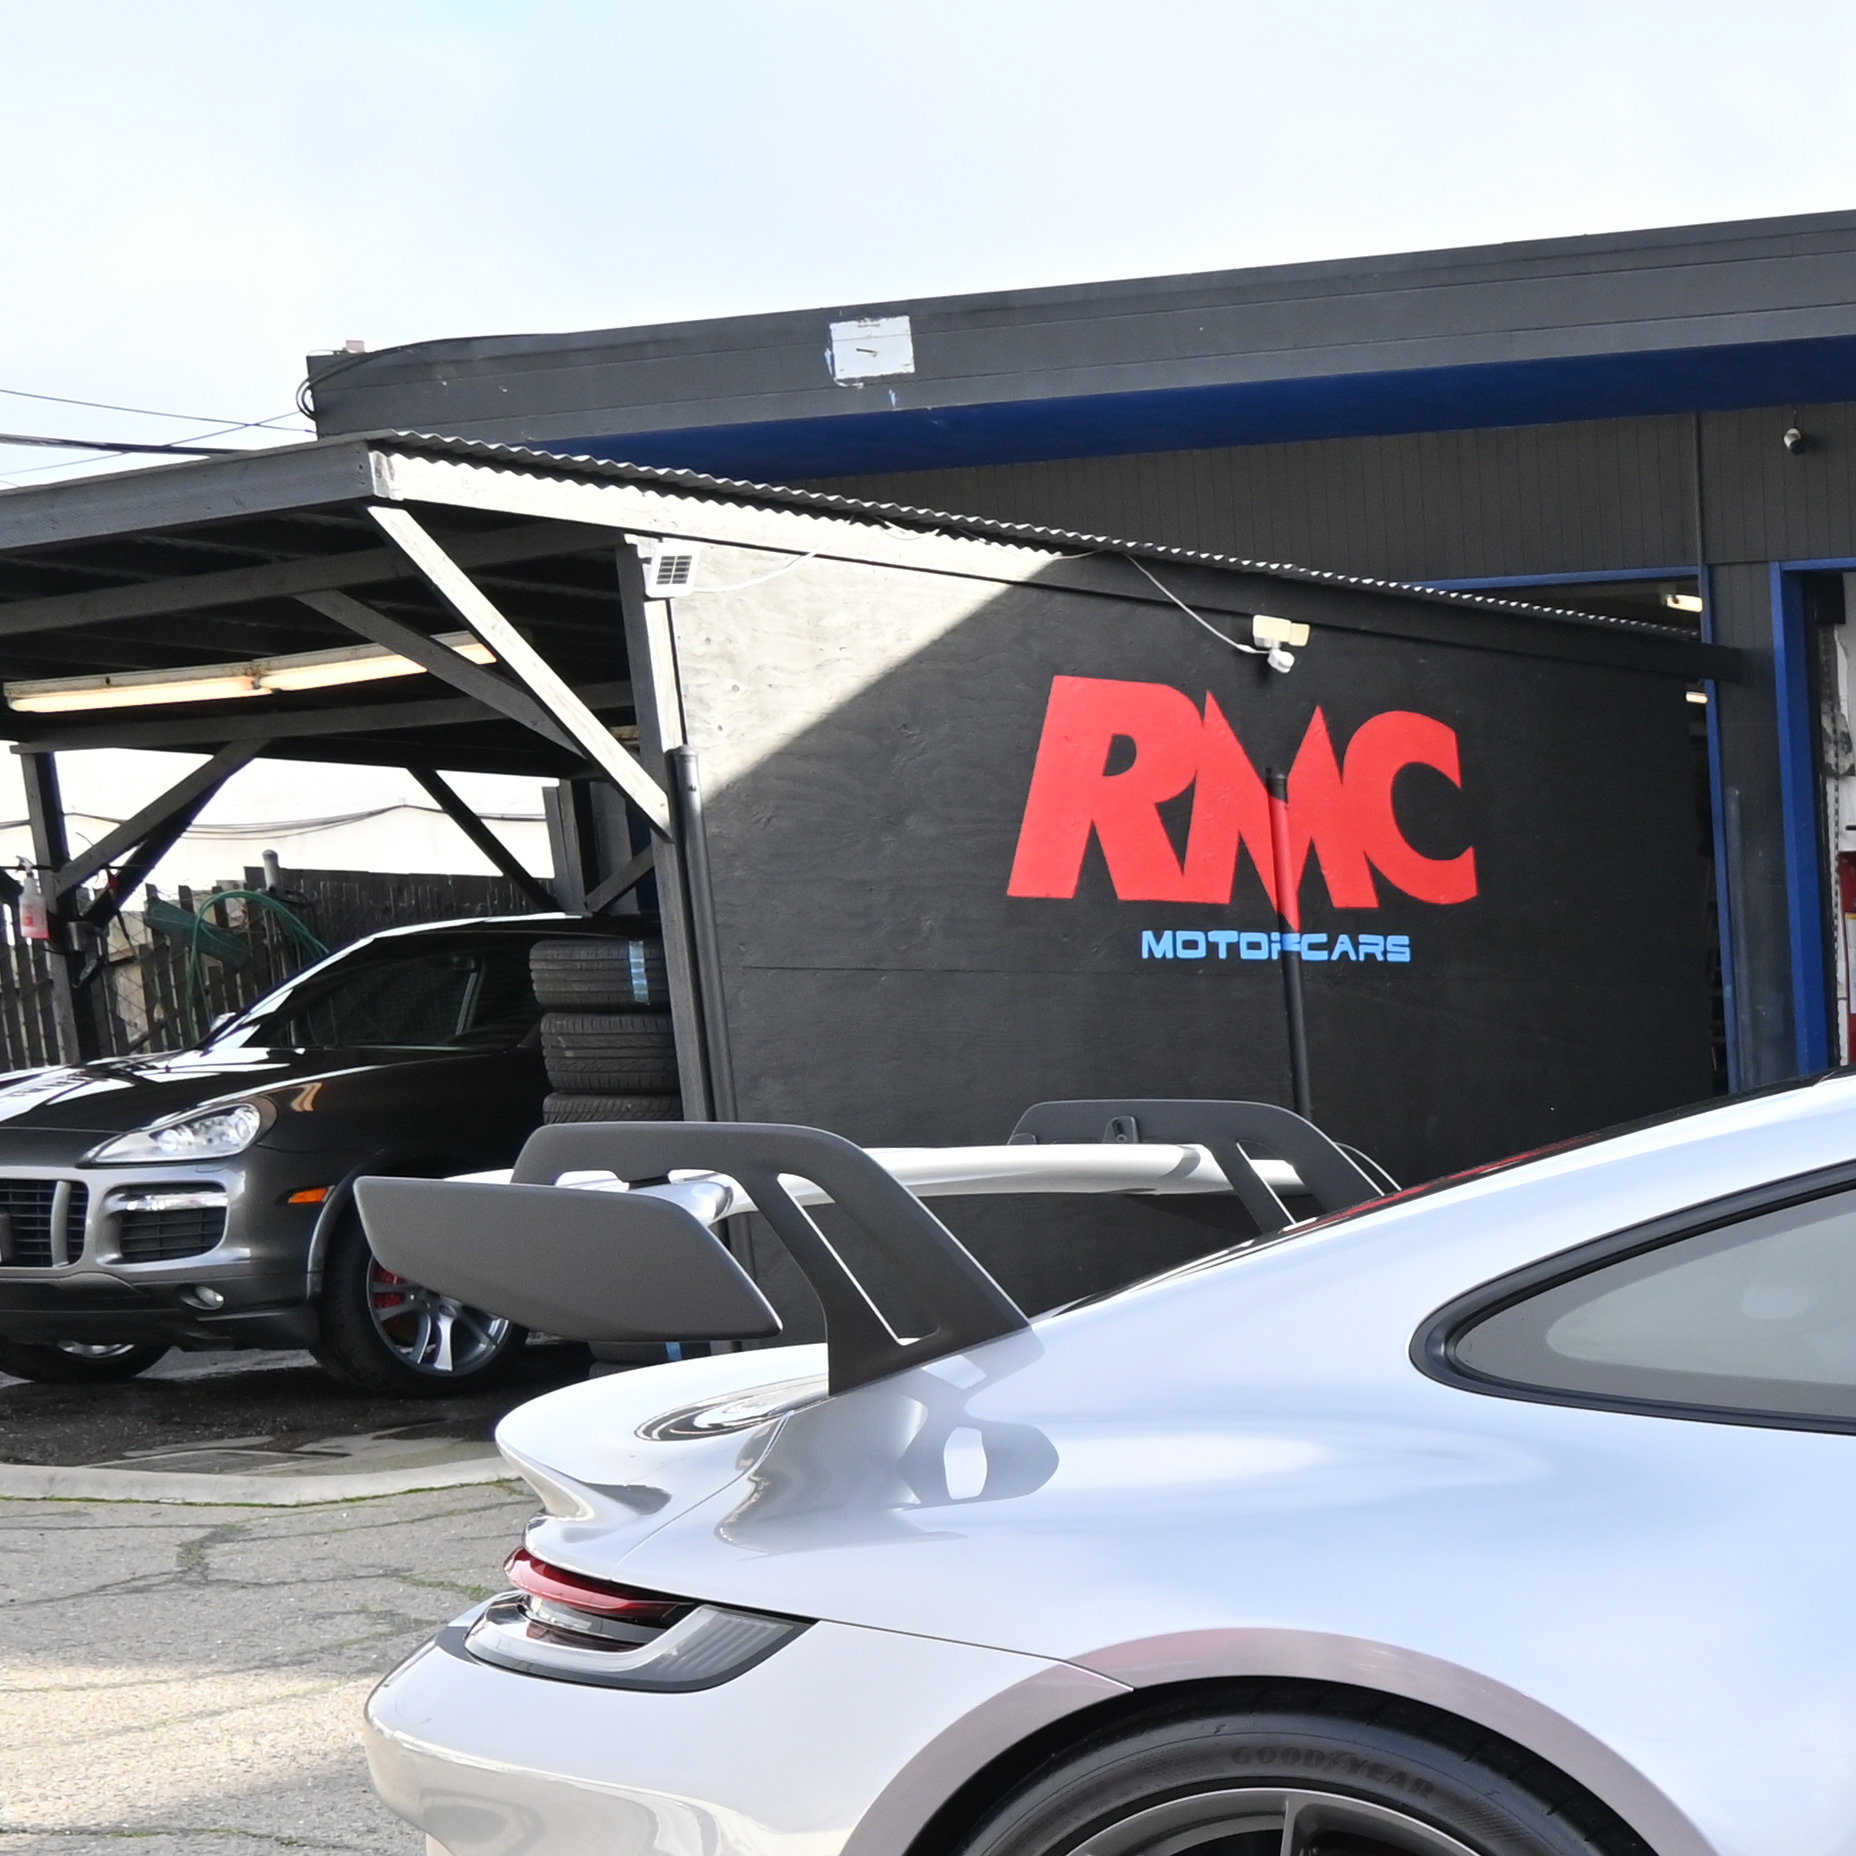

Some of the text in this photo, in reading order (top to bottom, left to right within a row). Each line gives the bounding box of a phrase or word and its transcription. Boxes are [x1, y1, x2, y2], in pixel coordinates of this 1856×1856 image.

[1006, 675, 1479, 932] RMC
[1141, 929, 1412, 963] MOTORCARS
[1232, 1746, 1436, 1798] GOODYEAR
